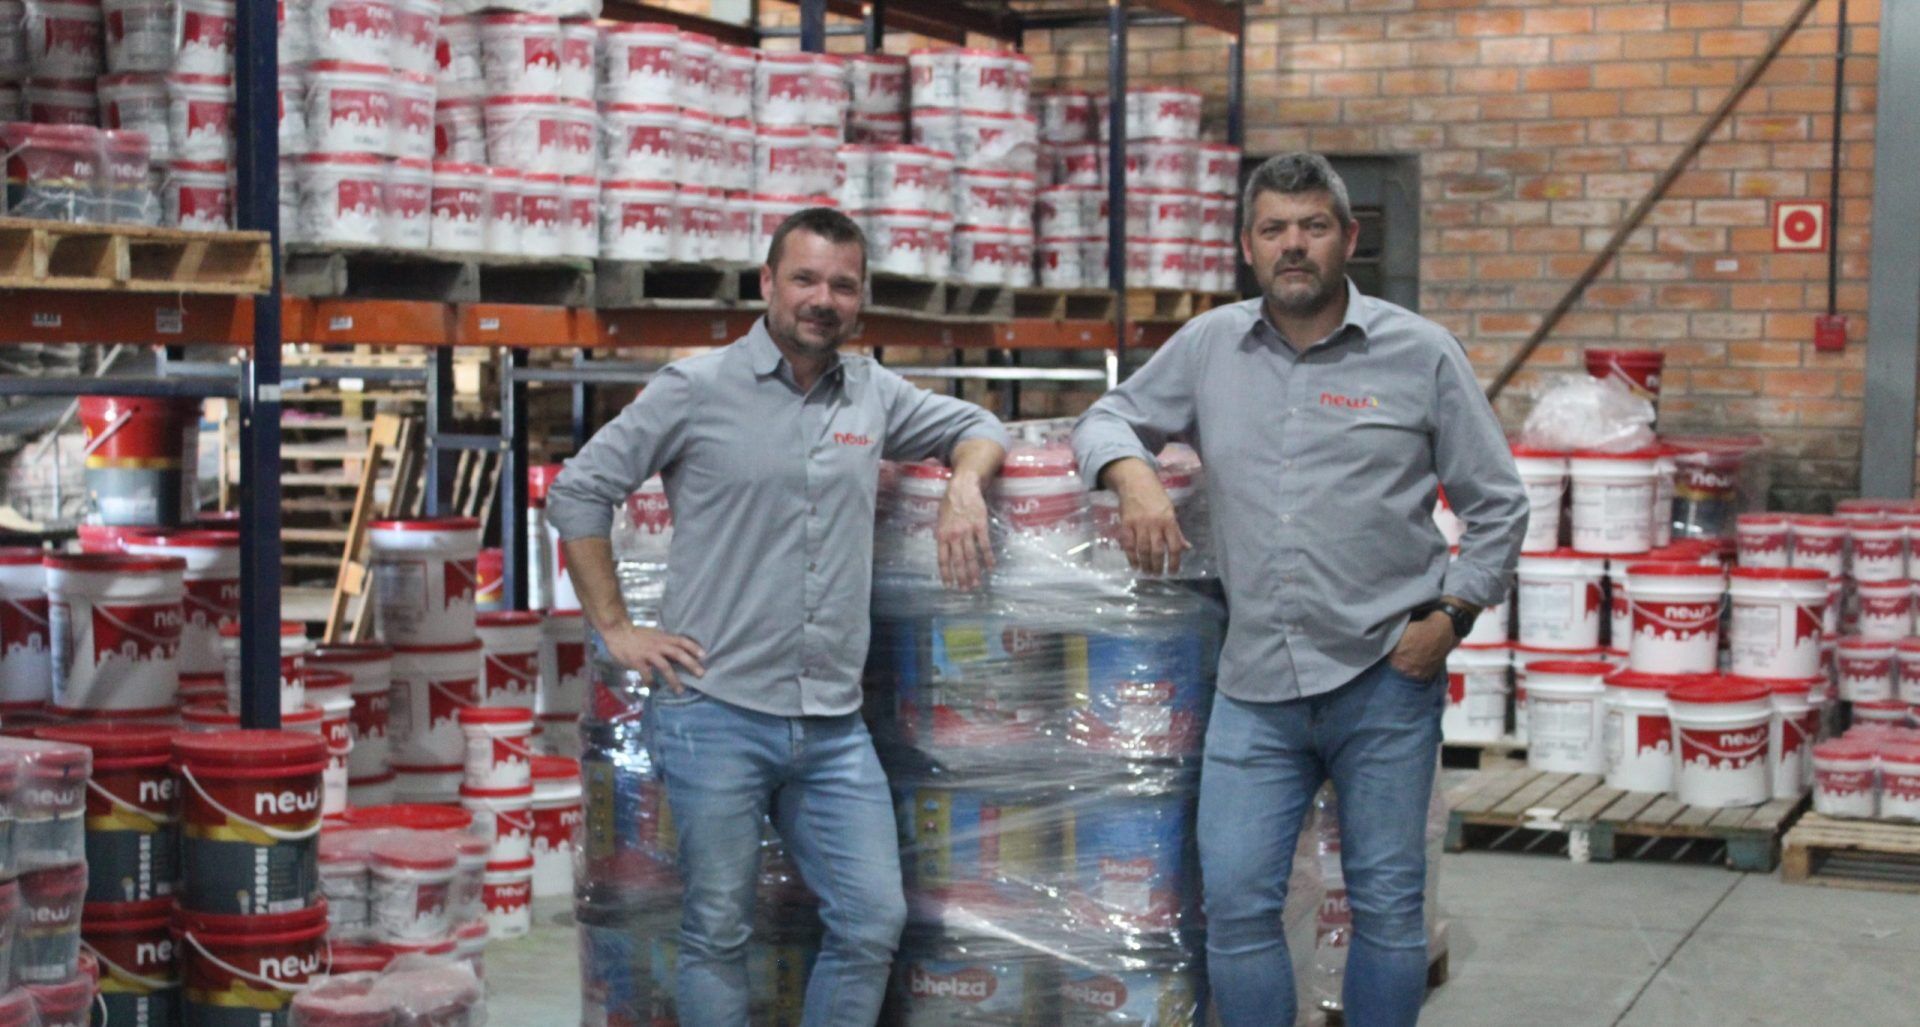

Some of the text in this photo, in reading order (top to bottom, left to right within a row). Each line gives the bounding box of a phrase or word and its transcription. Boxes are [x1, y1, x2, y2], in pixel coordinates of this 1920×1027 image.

[73, 160, 93, 176] ne
[1320, 391, 1368, 408] new
[833, 432, 869, 446] new
[1664, 605, 1712, 620] new
[1720, 729, 1765, 748] new
[139, 778, 173, 803] ne
[254, 788, 318, 816] new
[136, 938, 173, 966] ne
[259, 951, 319, 980] new
